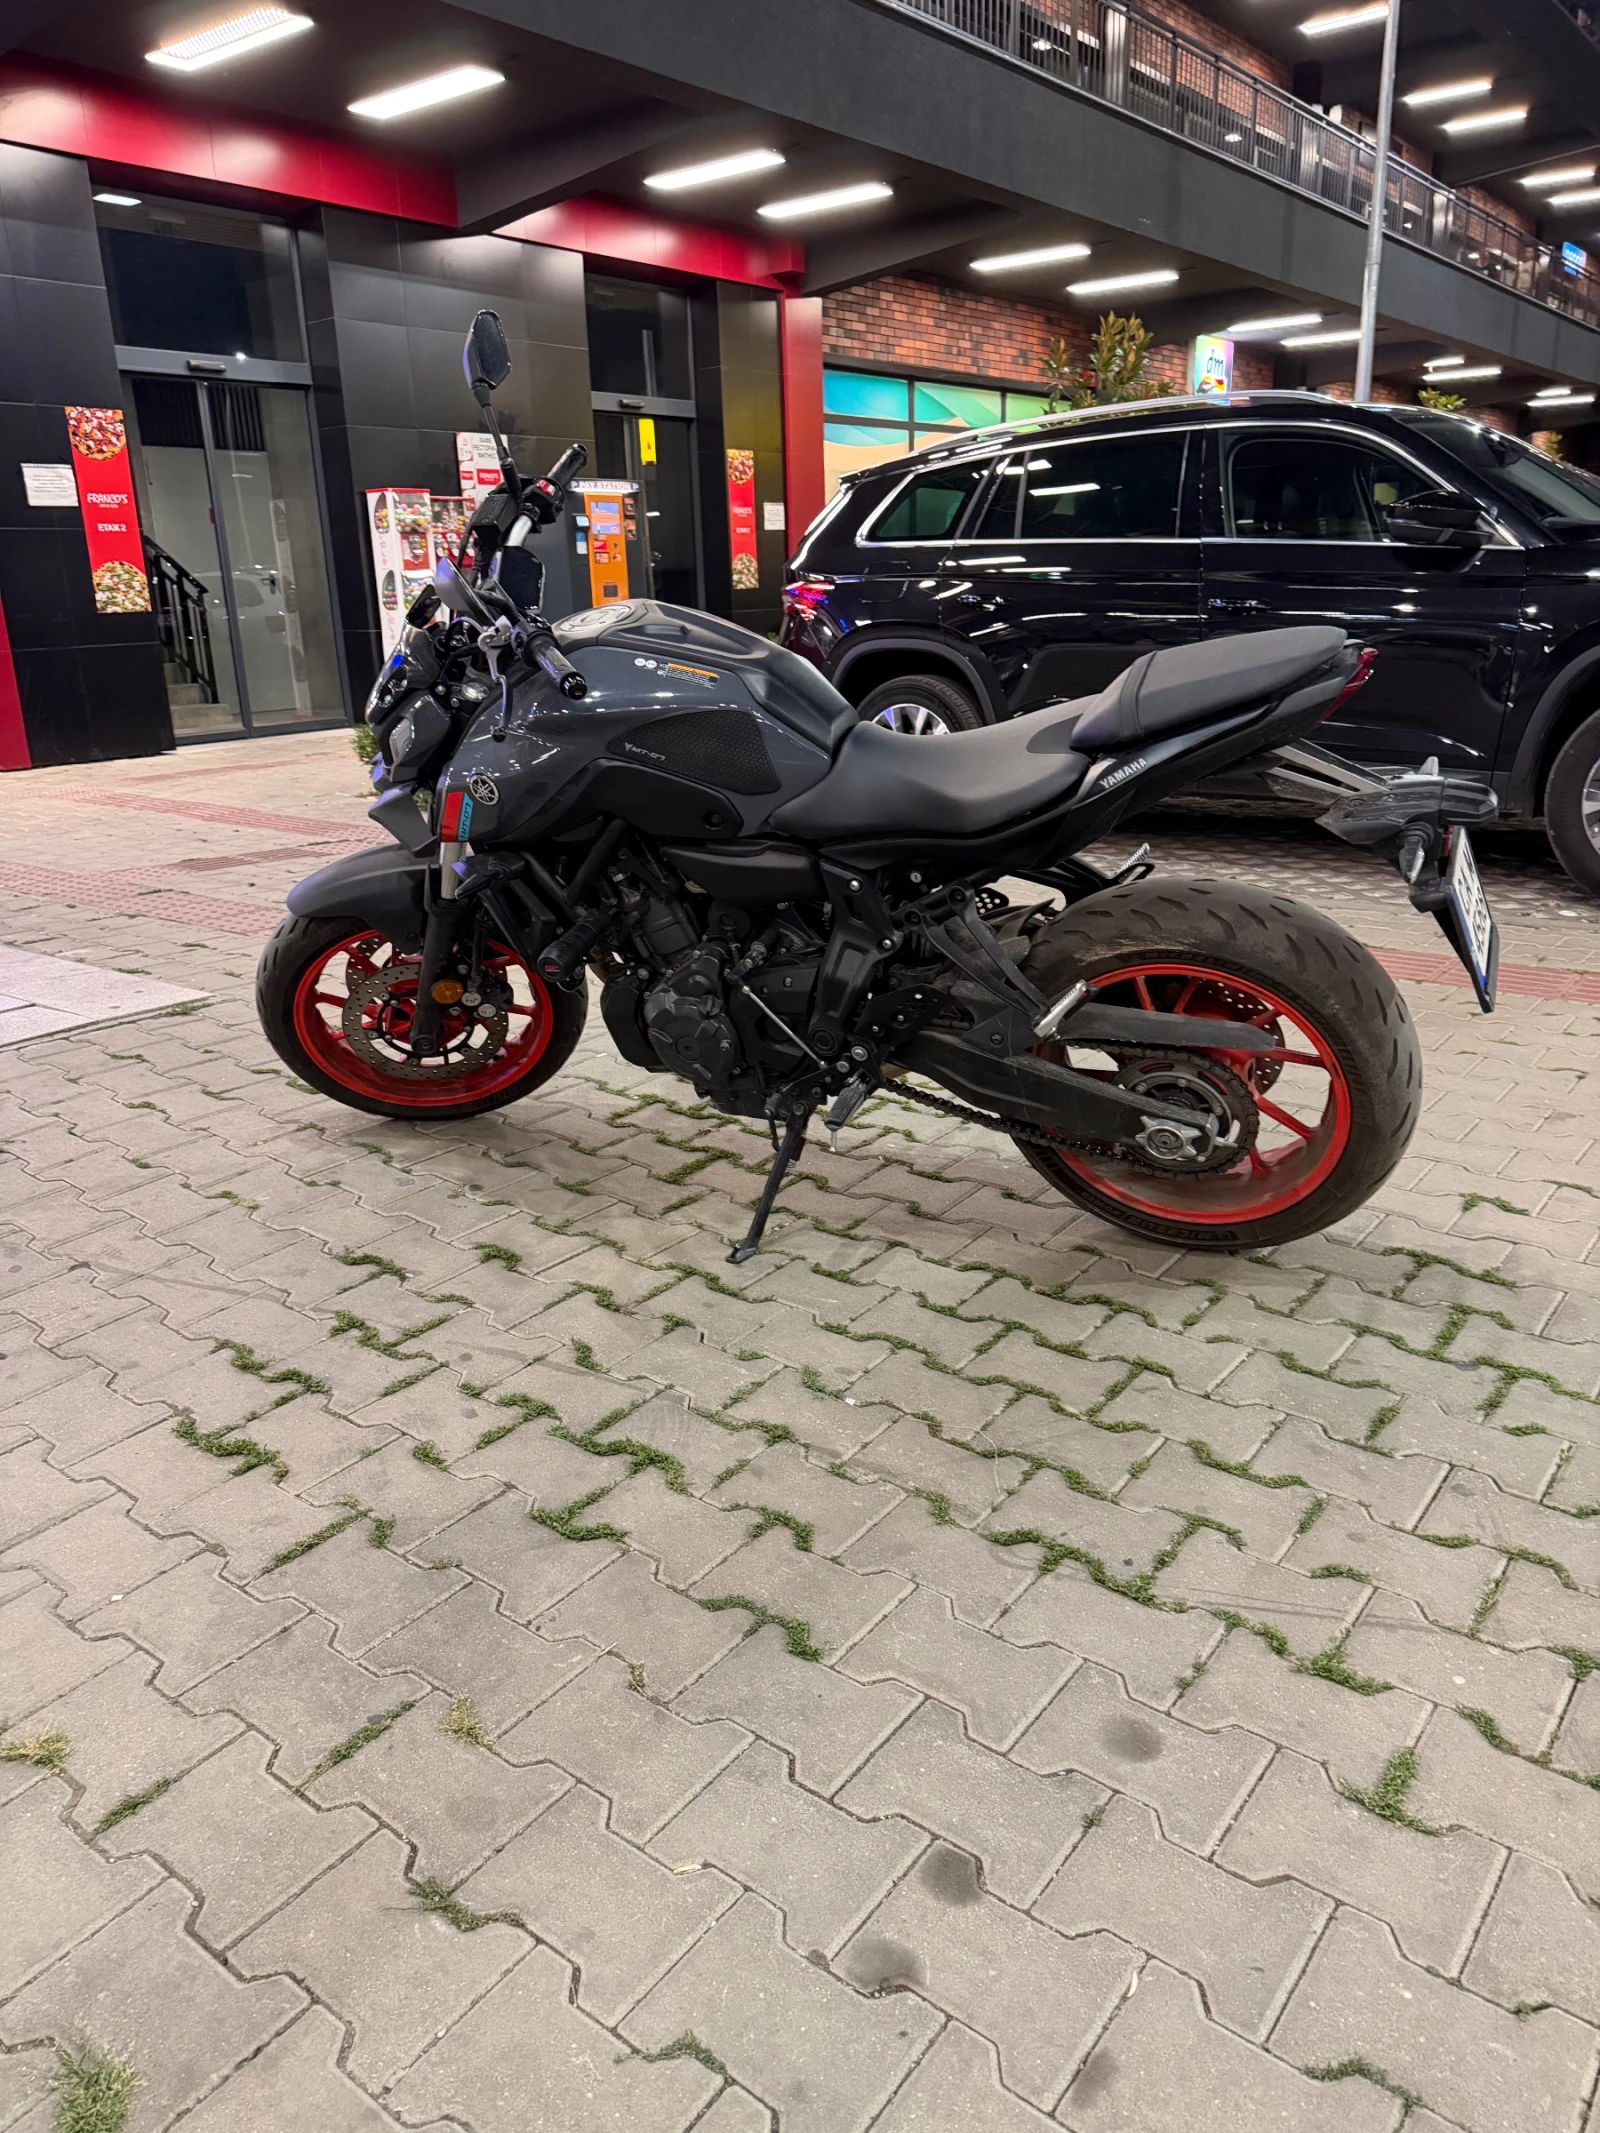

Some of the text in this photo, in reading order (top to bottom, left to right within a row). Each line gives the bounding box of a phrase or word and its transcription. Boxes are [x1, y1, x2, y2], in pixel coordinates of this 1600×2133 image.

[1206, 348, 1224, 376] dm
[87, 492, 129, 505] FRANCO'S
[630, 746, 666, 761] MT-07
[1097, 757, 1148, 789] YAMAHA
[460, 802, 471, 839] MT-07
[1126, 1214, 1212, 1241] MICHELIN
